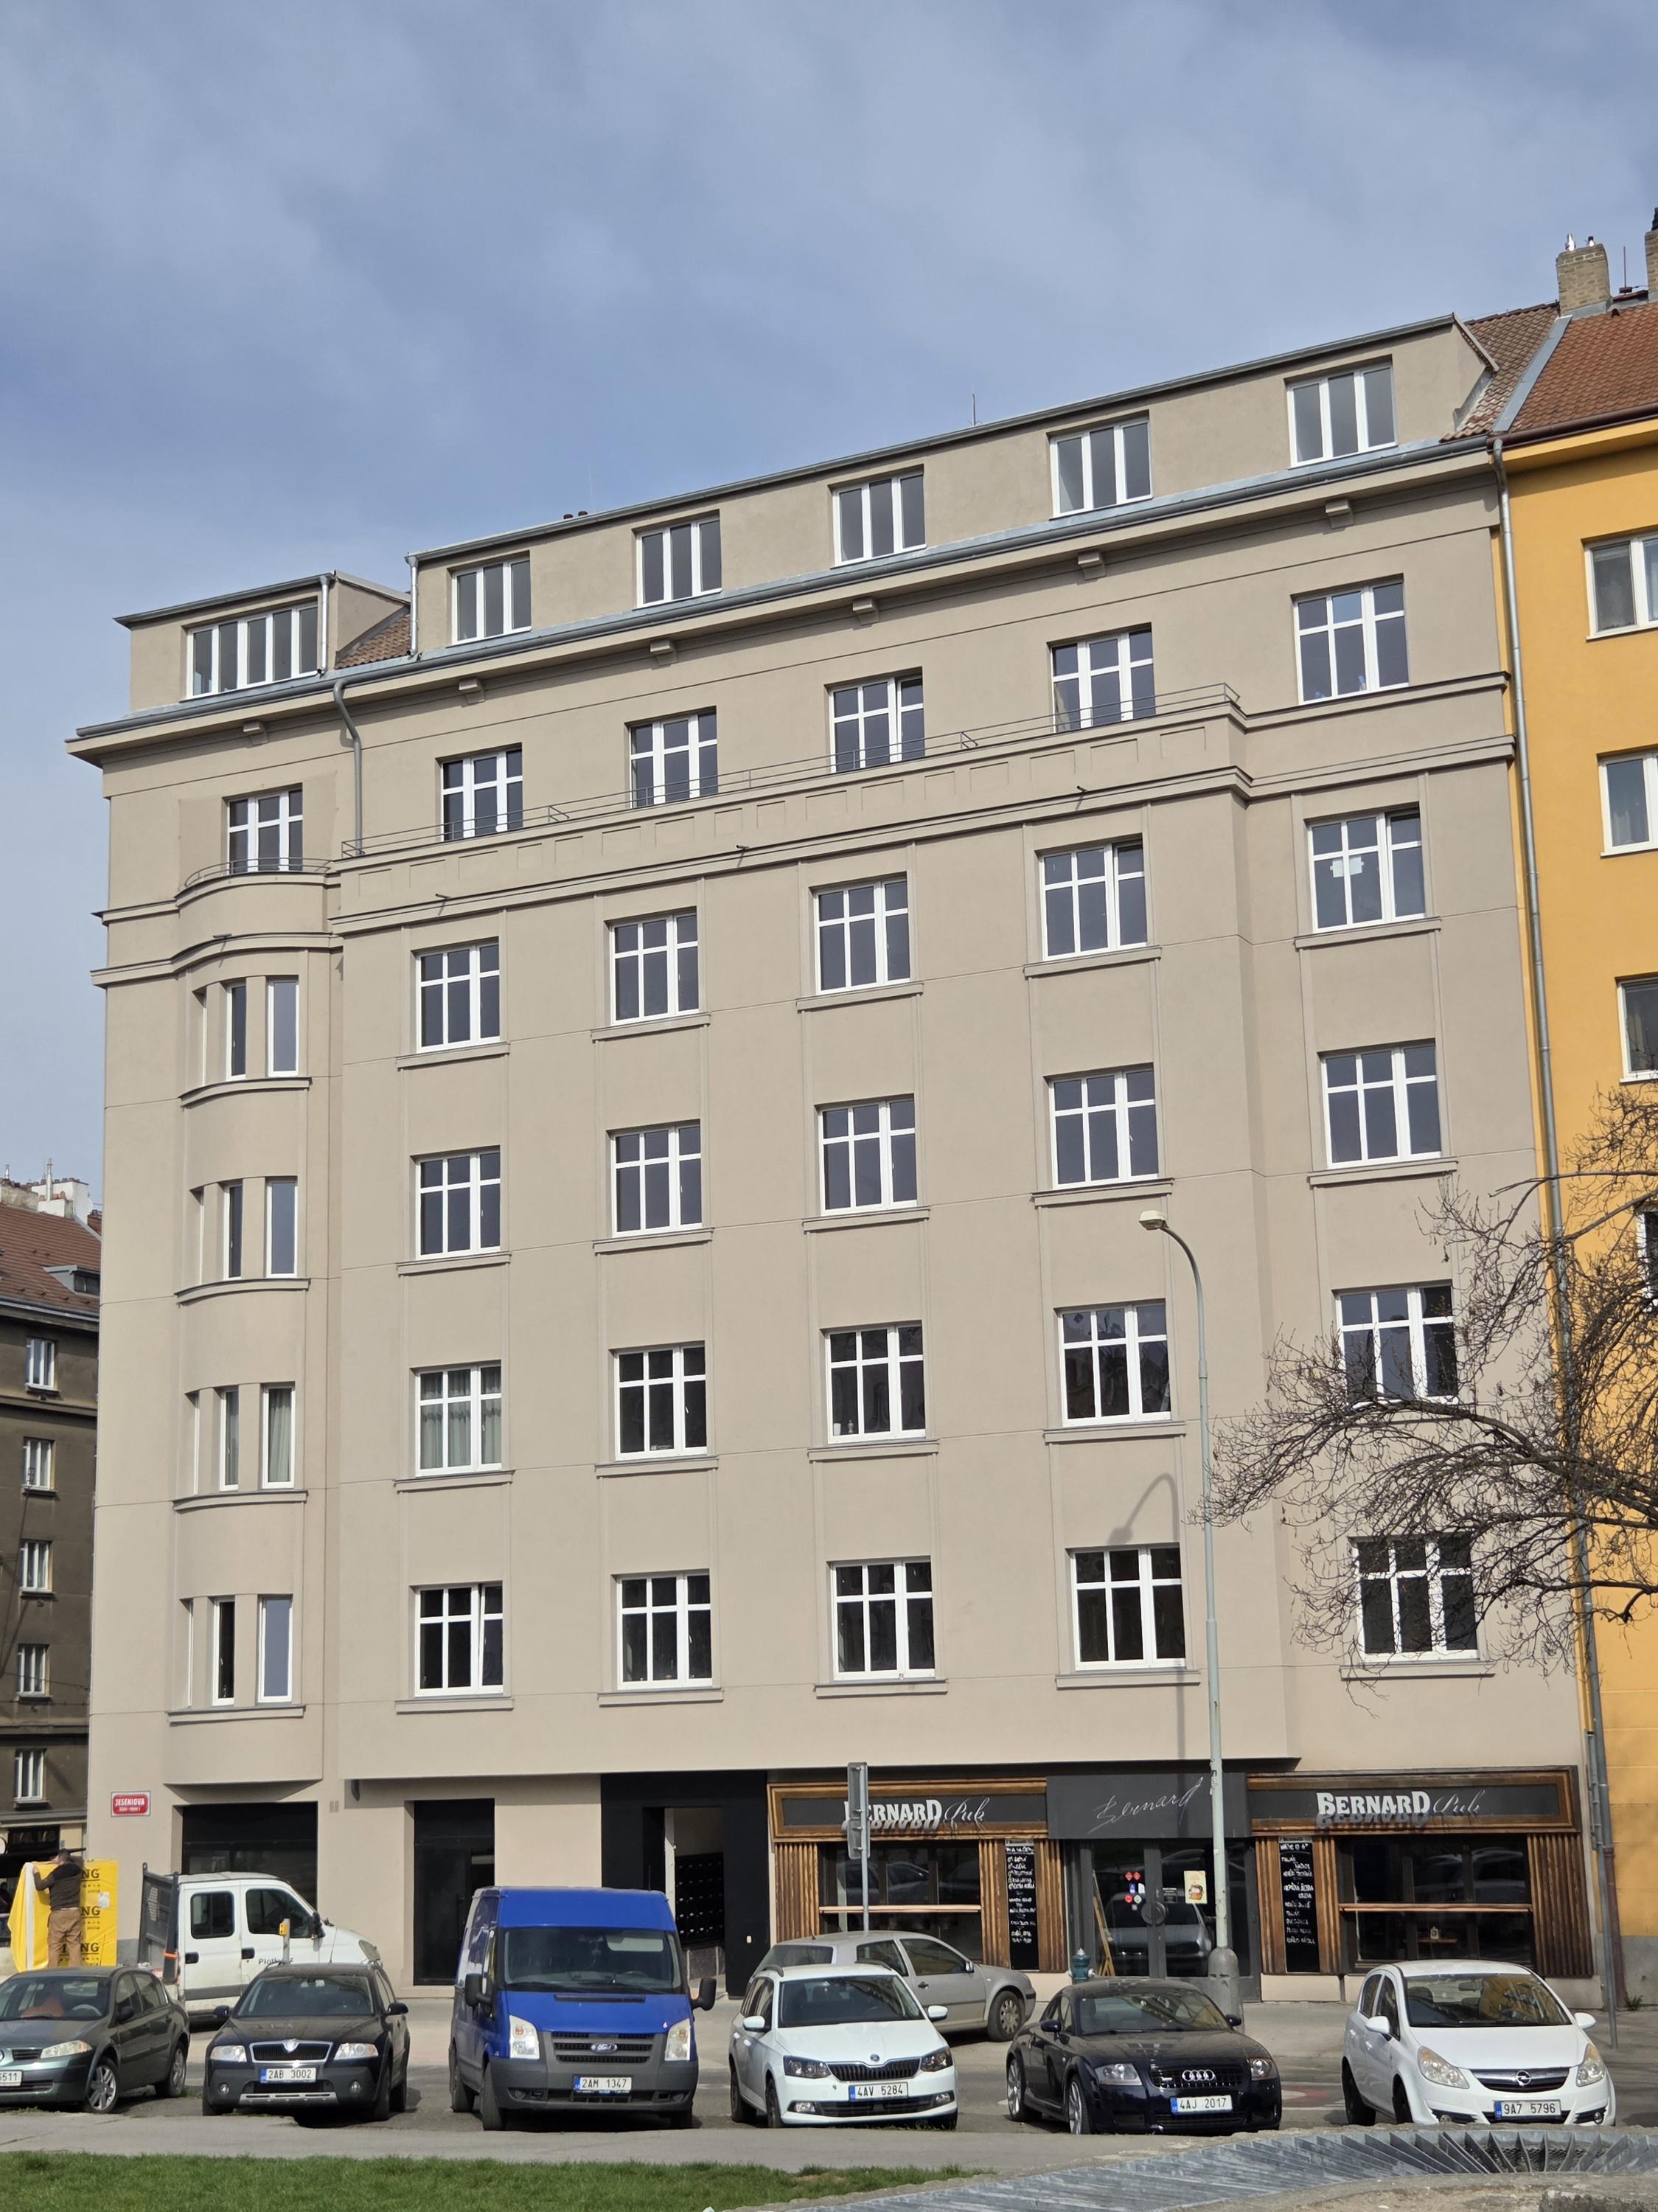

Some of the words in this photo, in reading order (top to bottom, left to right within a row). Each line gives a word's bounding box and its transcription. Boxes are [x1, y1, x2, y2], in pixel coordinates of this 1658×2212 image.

[115, 1798, 145, 1806] JESENIOVA
[1317, 1791, 1430, 1815] BERNARD
[844, 1799, 942, 1821] RNARD
[944, 1797, 990, 1821] Pub
[268, 2070, 285, 2079] 2AB
[290, 2069, 312, 2079] 3002
[582, 2079, 599, 2088] 2AM
[606, 2079, 627, 2088] 1347
[857, 2086, 874, 2096] 4AV
[881, 2084, 903, 2096] 5284
[1180, 2099, 1197, 2110] 4AJ
[1205, 2098, 1227, 2108] 2017
[1504, 2104, 1522, 2115] 9A7
[1530, 2103, 1556, 2114] 5796
